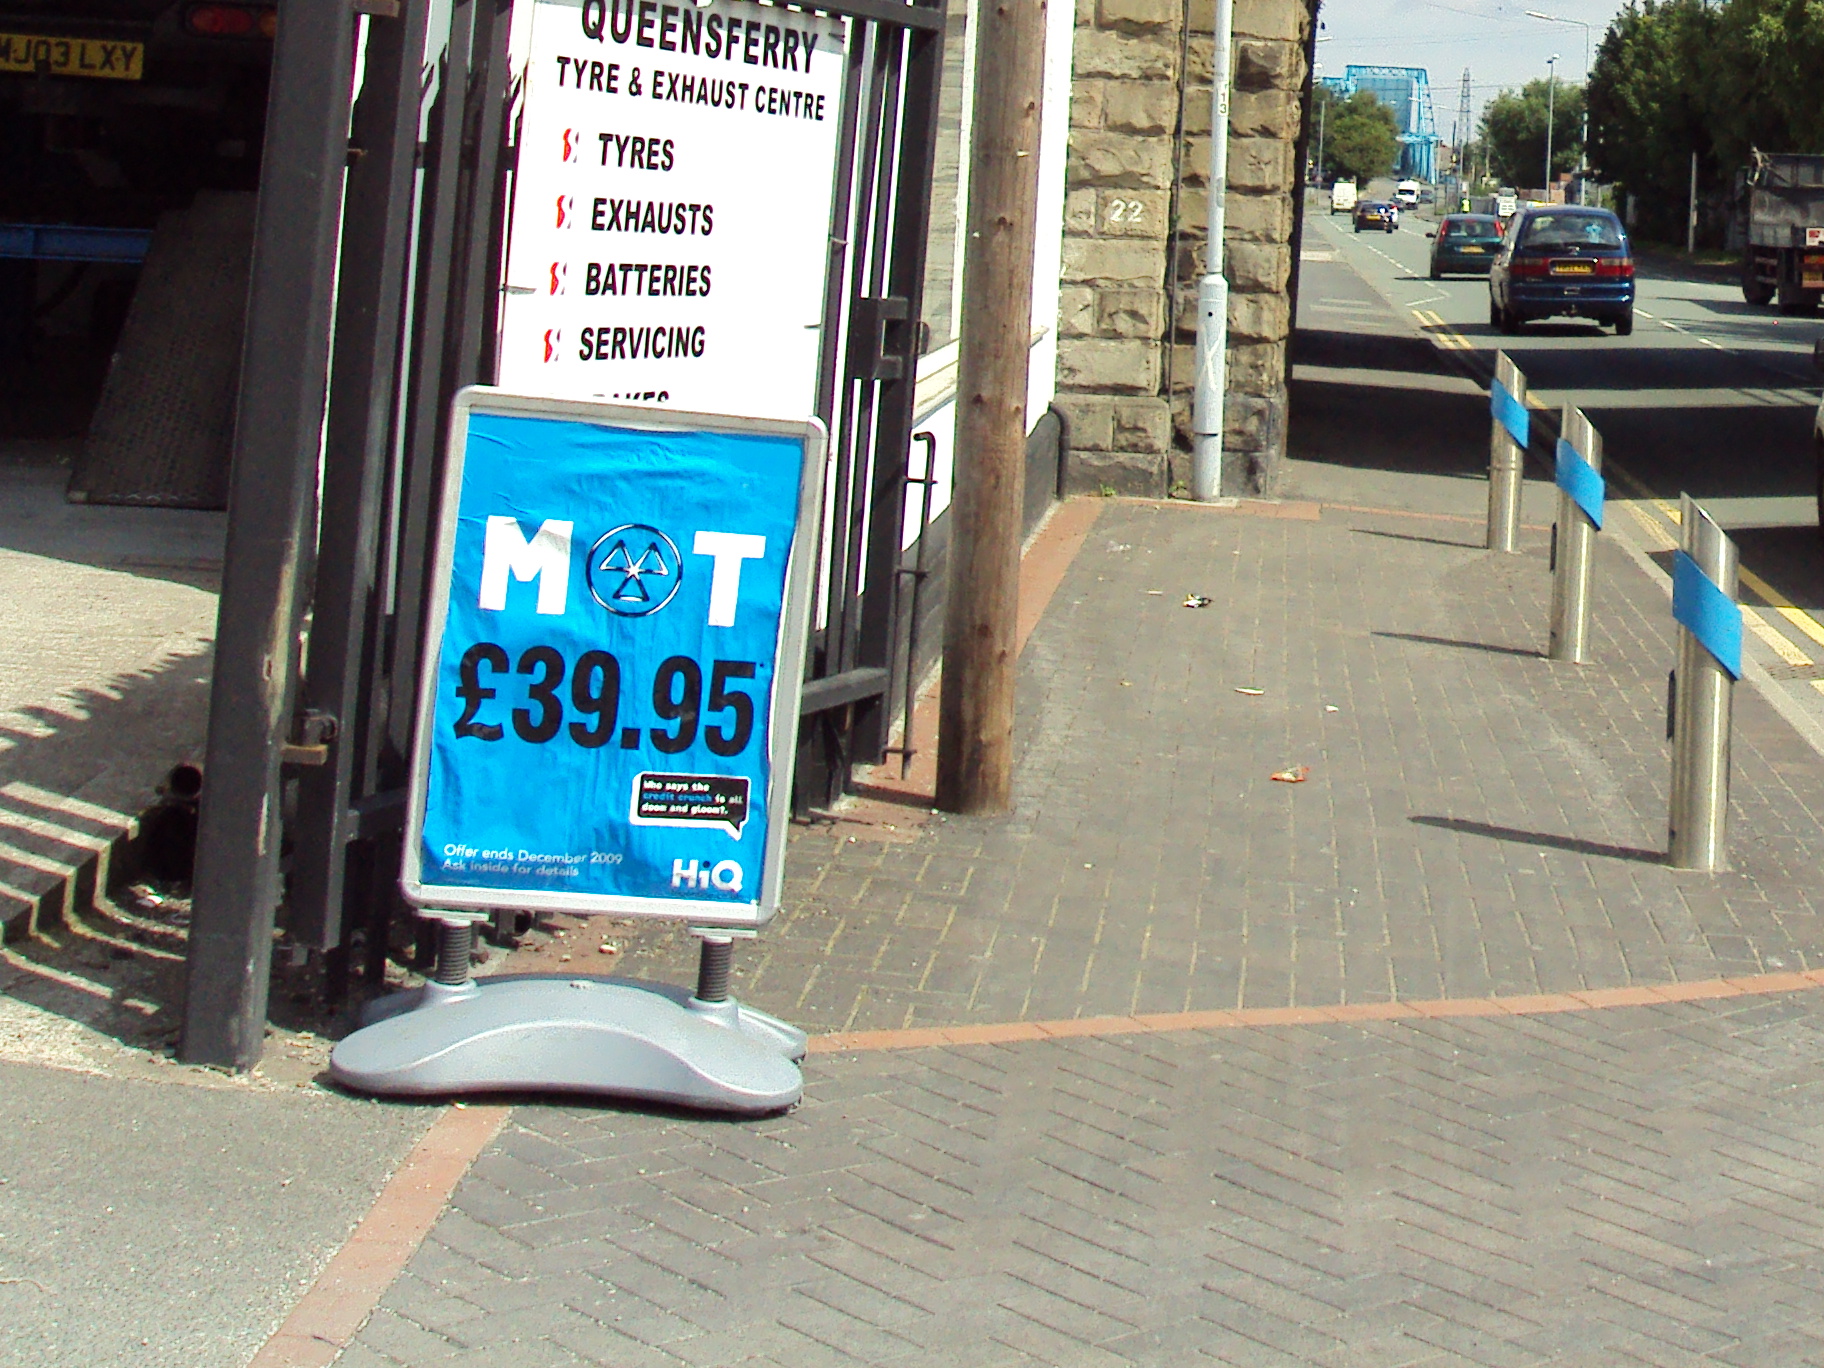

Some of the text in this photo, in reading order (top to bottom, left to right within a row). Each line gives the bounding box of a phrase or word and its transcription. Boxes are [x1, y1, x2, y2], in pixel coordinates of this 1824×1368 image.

[79, 43, 138, 72] LXY
[557, 56, 825, 121] TYRE & EXHAUST CENTRE
[599, 133, 674, 172] TYRES
[591, 197, 713, 236] EXHAUSTS
[1110, 199, 1143, 222] 22
[585, 262, 711, 297] BATTERIES
[579, 325, 705, 361] SERVICING
[453, 642, 756, 758] £39.95
[643, 792, 675, 801] credit
[678, 794, 712, 802] crunch
[692, 782, 710, 791] the
[669, 803, 688, 813] and
[442, 858, 579, 877] Ask inside for details
[444, 844, 623, 865] Offer ends December 2009
[671, 858, 743, 893] HiQ
